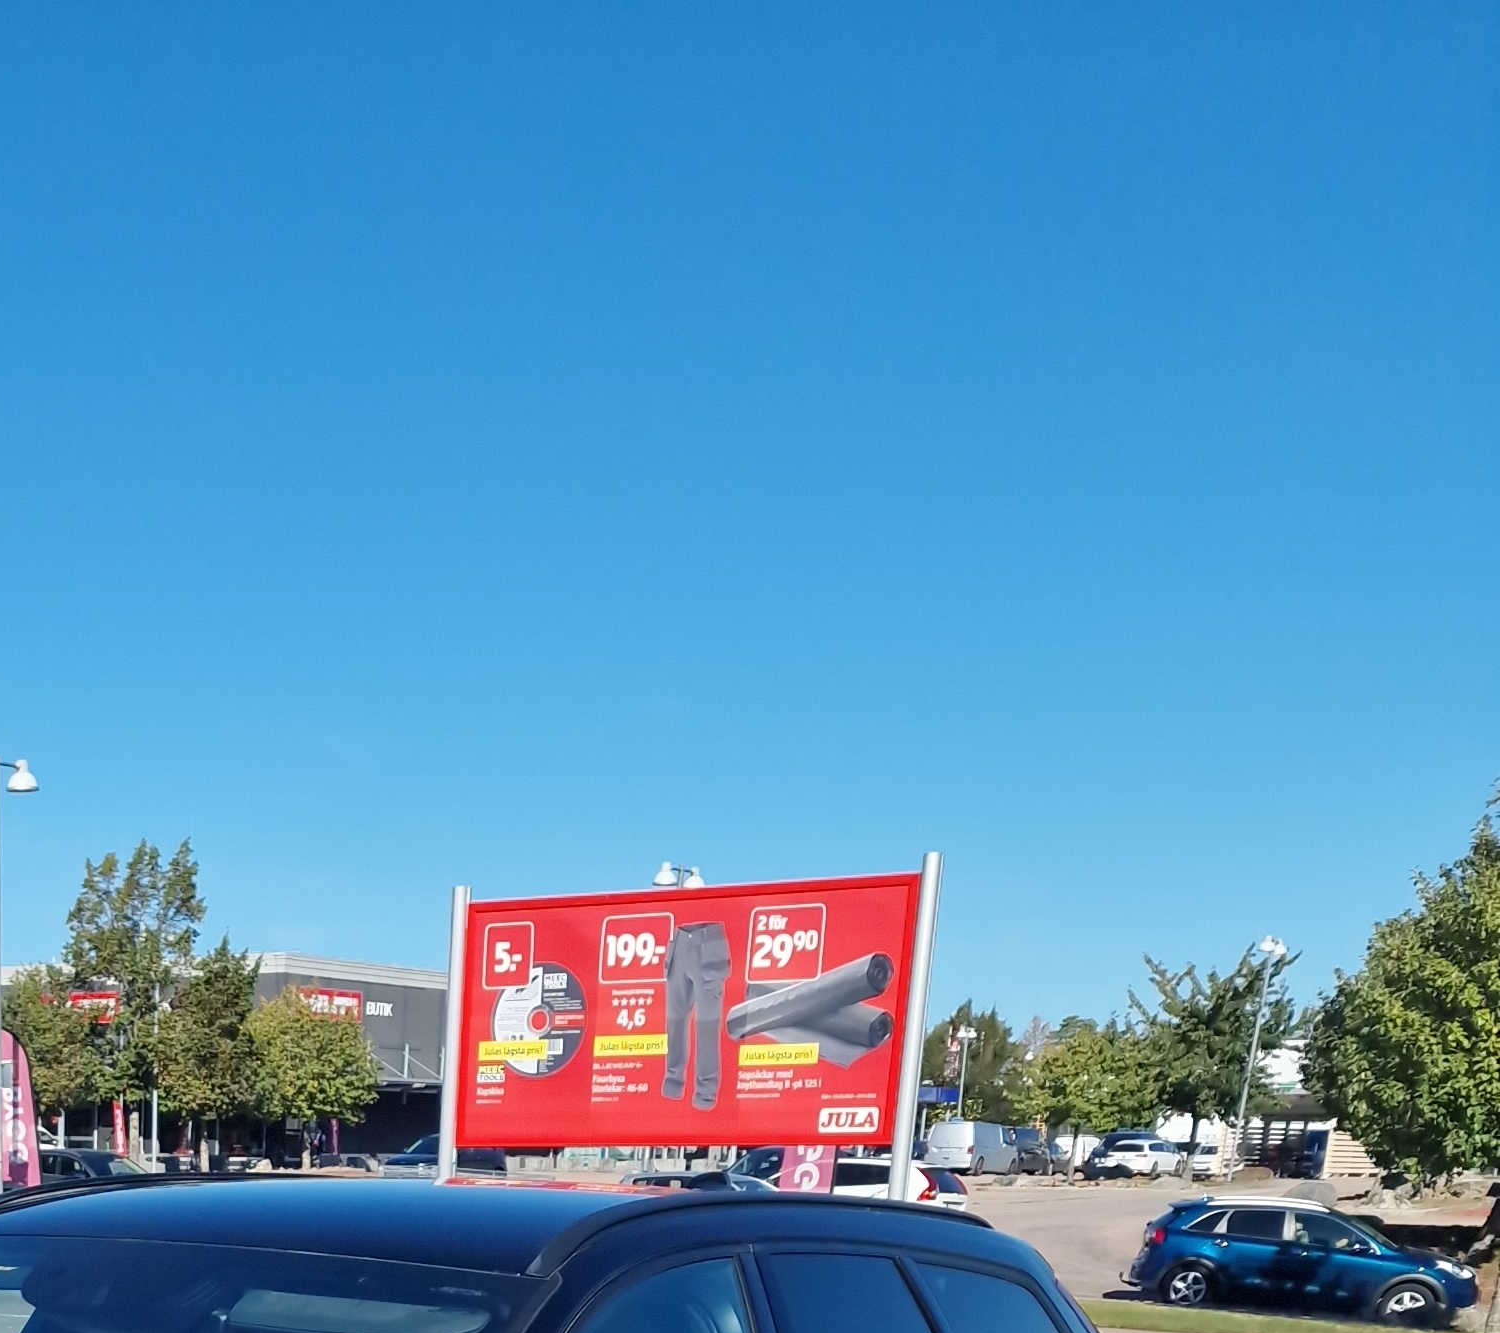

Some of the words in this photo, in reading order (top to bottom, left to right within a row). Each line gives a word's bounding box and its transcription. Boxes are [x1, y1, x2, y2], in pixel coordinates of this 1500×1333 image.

[756, 914, 768, 931] 2
[768, 913, 789, 931] för
[366, 1001, 394, 1017] BUTIK
[616, 1008, 647, 1031] 4,6
[744, 1051, 766, 1061] Julas
[820, 1111, 876, 1128] JULA
